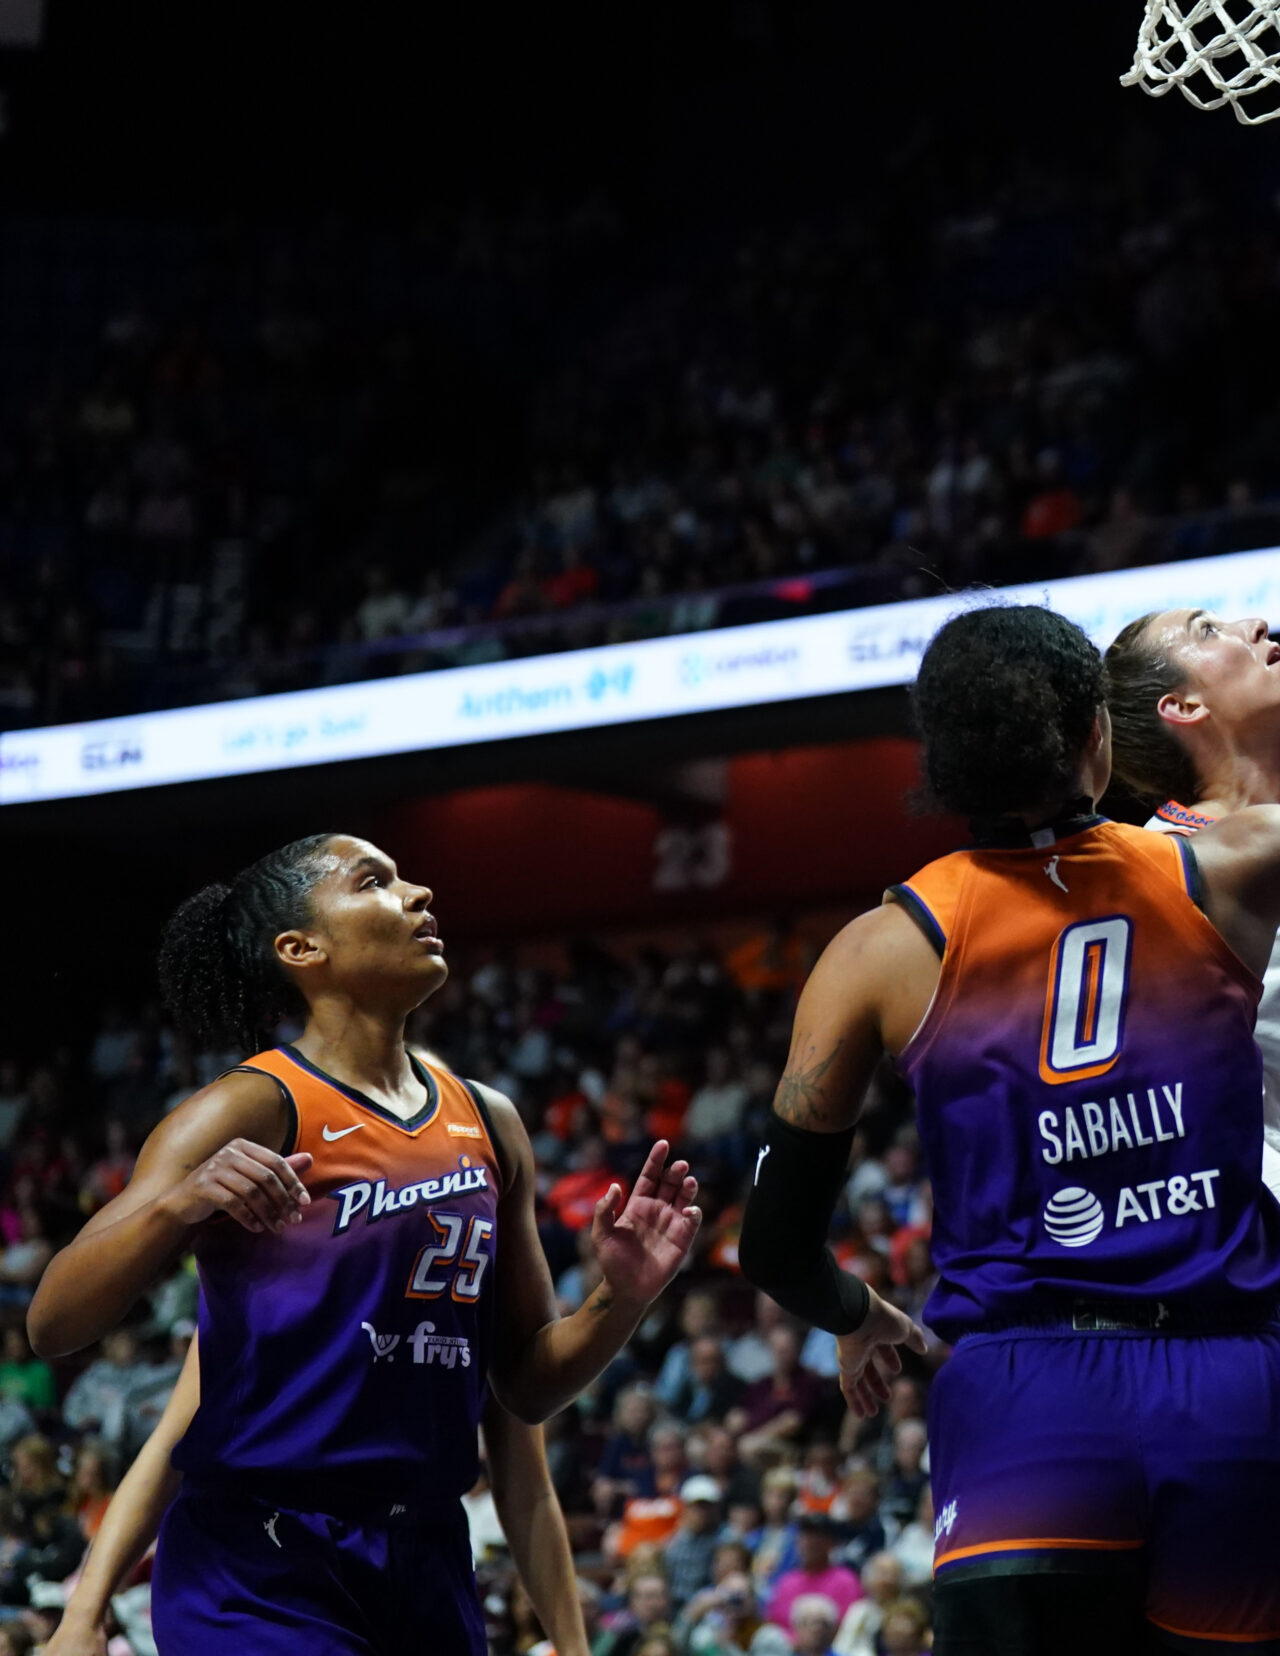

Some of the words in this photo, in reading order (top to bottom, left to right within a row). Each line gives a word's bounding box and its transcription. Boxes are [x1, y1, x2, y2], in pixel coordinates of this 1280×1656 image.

[456, 681, 573, 719] Anthem
[1039, 914, 1134, 1085] 0
[1038, 1083, 1185, 1165] SABALLY
[332, 1155, 489, 1234] Phoenix
[1115, 1169, 1220, 1228] AT&T
[405, 1211, 492, 1303] 25
[406, 1321, 471, 1369] fry's
